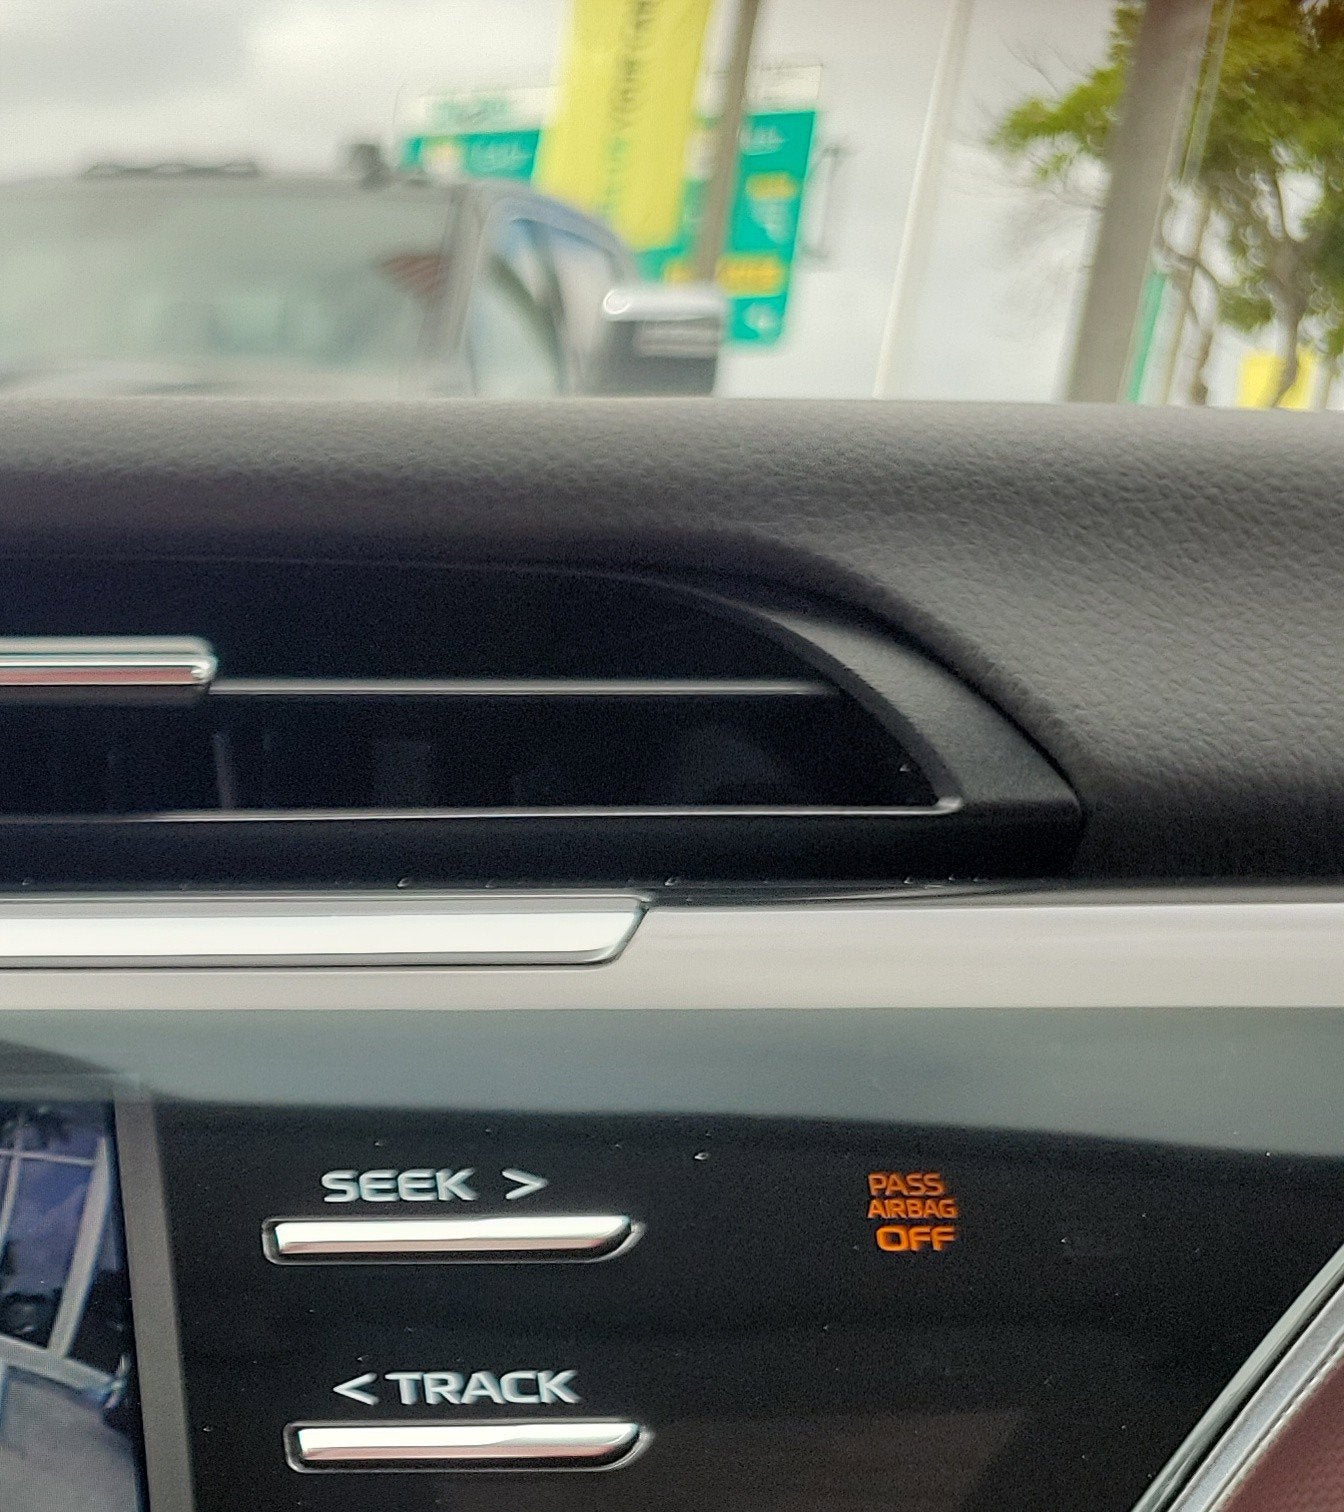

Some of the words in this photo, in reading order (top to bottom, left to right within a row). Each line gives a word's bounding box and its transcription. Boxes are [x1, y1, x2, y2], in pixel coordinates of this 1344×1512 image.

[321, 1169, 476, 1202] SEEK
[867, 1172, 944, 1196] PASS
[867, 1199, 959, 1219] AIRBAG
[875, 1226, 957, 1252] OFF
[384, 1369, 580, 1404] TRACK
